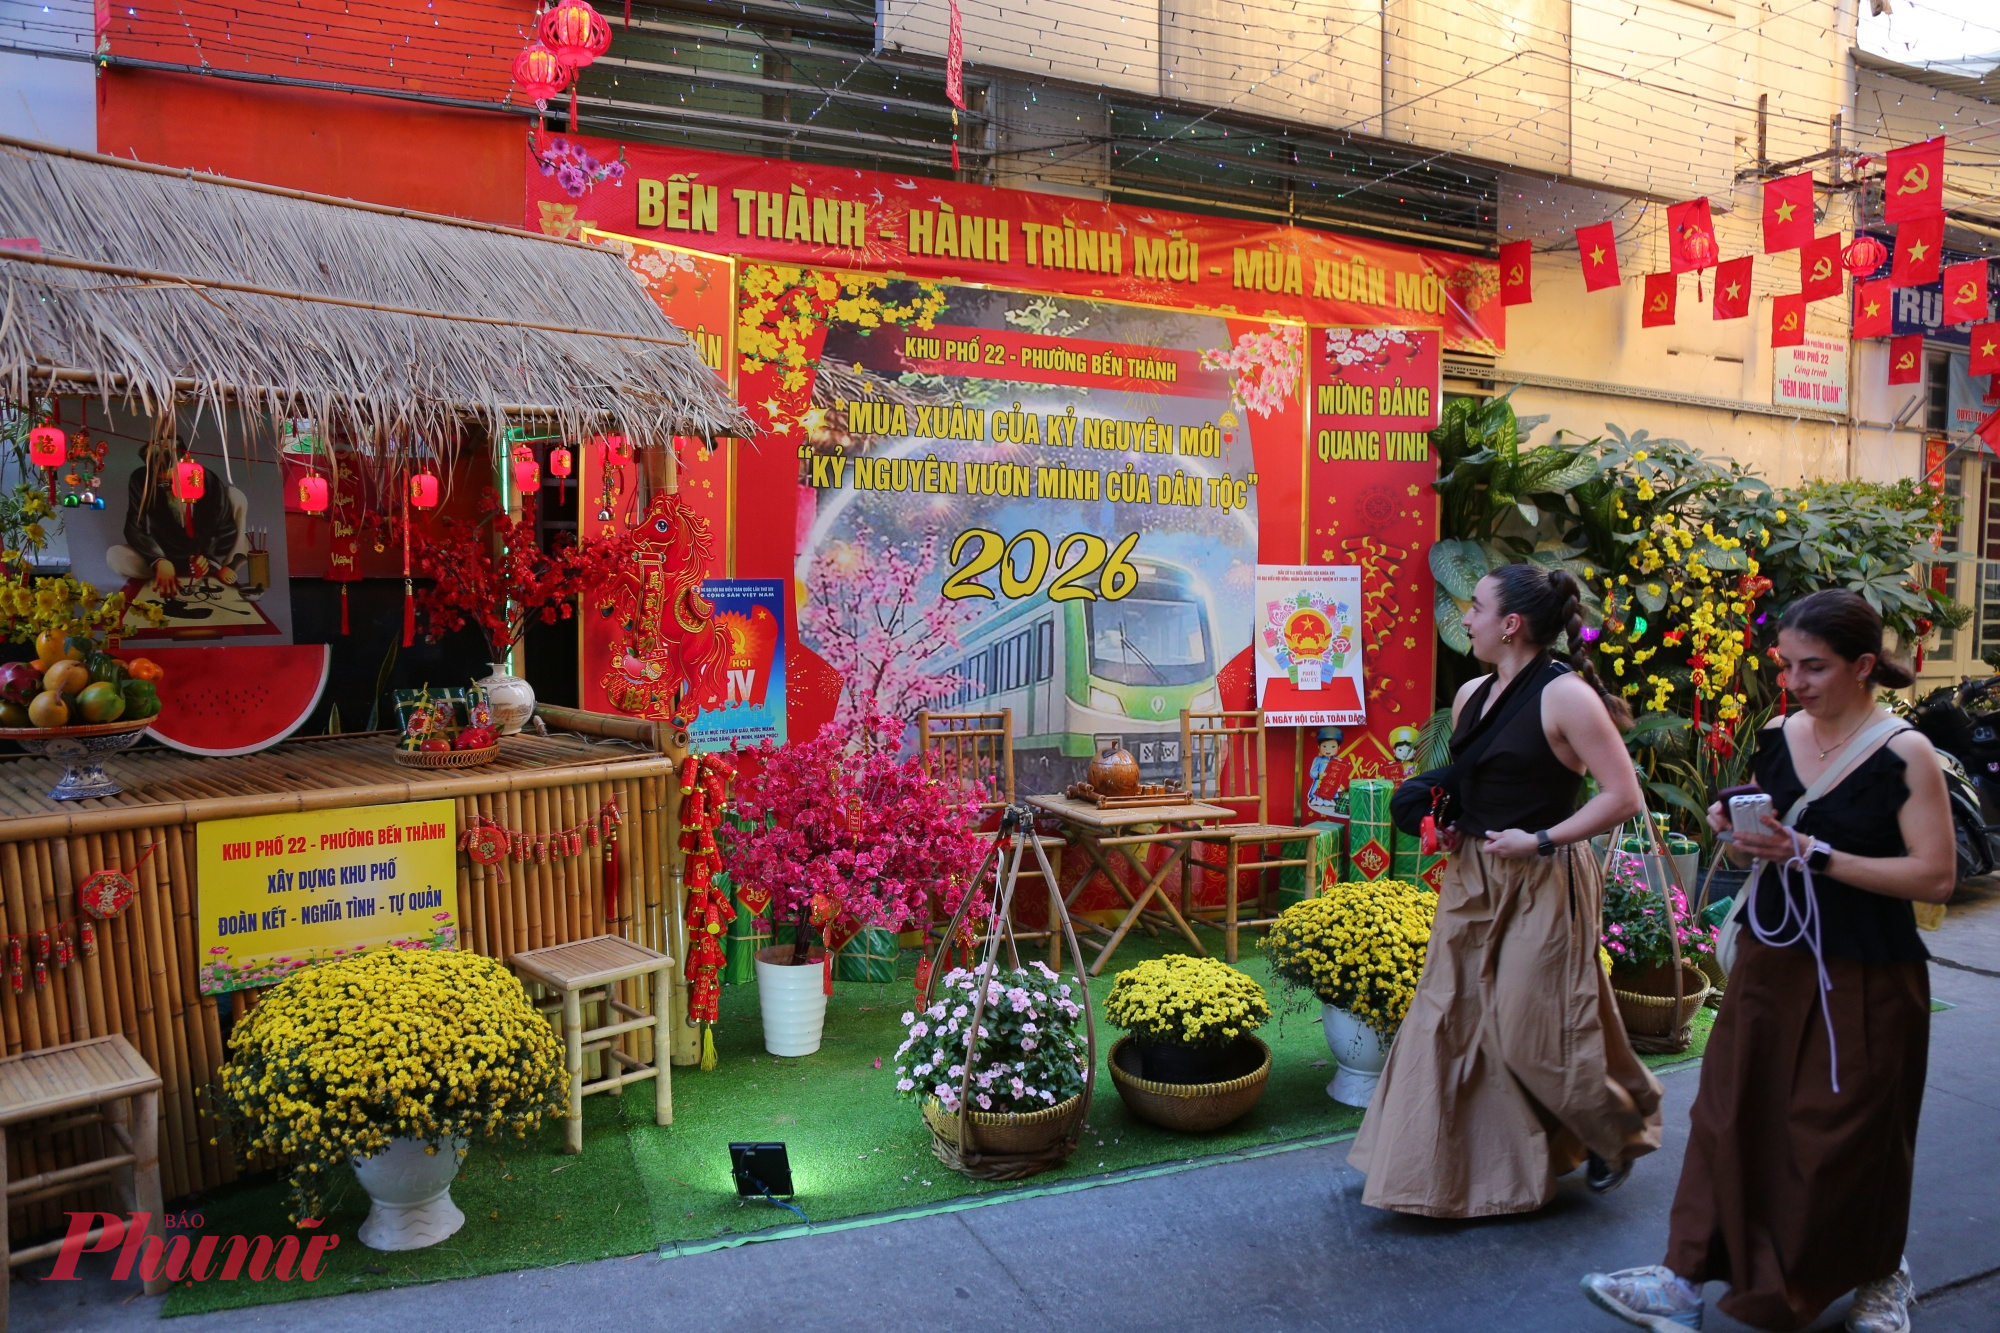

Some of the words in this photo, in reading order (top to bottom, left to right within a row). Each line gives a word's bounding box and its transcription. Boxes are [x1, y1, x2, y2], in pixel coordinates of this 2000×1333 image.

[638, 172, 718, 232] BẾN
[733, 182, 865, 247] THÀNH
[909, 201, 1009, 262] HÀNH
[1022, 215, 1122, 274] TRÌNH
[1133, 231, 1199, 283] MỚI
[1233, 241, 1303, 296] MÙA
[1313, 255, 1386, 306] XUÂN
[1395, 267, 1446, 315] MỚI
[1891, 287, 1943, 336] RỤ
[905, 336, 940, 360] KHU
[945, 335, 980, 363] PHỐ
[984, 344, 1005, 365] 22
[1021, 346, 1087, 373] PHƯỜNG
[1091, 350, 1123, 376] BẾN
[1127, 356, 1177, 382] THÀNH
[1793, 349, 1806, 361] KHU
[1807, 350, 1819, 363] PHỐ
[1820, 354, 1829, 365] 22
[1794, 365, 1810, 377] Công
[1318, 378, 1374, 416] MỪNG
[1378, 376, 1430, 417] ĐẢNG
[1798, 381, 1811, 400] HOA
[1813, 383, 1821, 405] TỰ
[849, 396, 908, 437] MÙA
[915, 401, 984, 441] XUÂN
[991, 401, 1041, 445] CỦA
[1047, 406, 1077, 447] KỶ
[1083, 416, 1173, 454] NGUYÊN
[1179, 421, 1221, 458] MỚI
[1318, 429, 1380, 464] QUANG
[1385, 431, 1429, 462] VINH
[854, 454, 957, 494] NGUYÊN
[964, 461, 1030, 497] VƯƠN
[1037, 462, 1100, 501] MÌNH
[1106, 462, 1151, 504] CỦA
[1157, 469, 1202, 507] DÂN
[941, 528, 1140, 603] 2026
[732, 658, 751, 669] HỘI
[1272, 713, 1292, 724] NGÀY
[1295, 714, 1307, 725] HỘI
[1310, 712, 1325, 723] CỦA
[1327, 712, 1346, 723] TOÀN
[222, 841, 251, 861] KHU
[255, 834, 285, 858] PHỐ
[288, 837, 306, 854] 22
[320, 827, 374, 851] PHƯỜNG
[378, 824, 402, 846] BẾN
[406, 821, 446, 842] THÀNH
[267, 868, 293, 894] XÂY
[299, 867, 336, 893] DỰNG
[340, 865, 366, 885] KHU
[370, 857, 398, 881] PHỐ
[218, 910, 257, 936] ĐOÀN
[262, 905, 287, 931] KẾT
[301, 899, 342, 926] NGHĨA
[346, 897, 375, 919] TÌNH
[389, 892, 405, 916] TỰ
[409, 885, 442, 911] QUẢN
